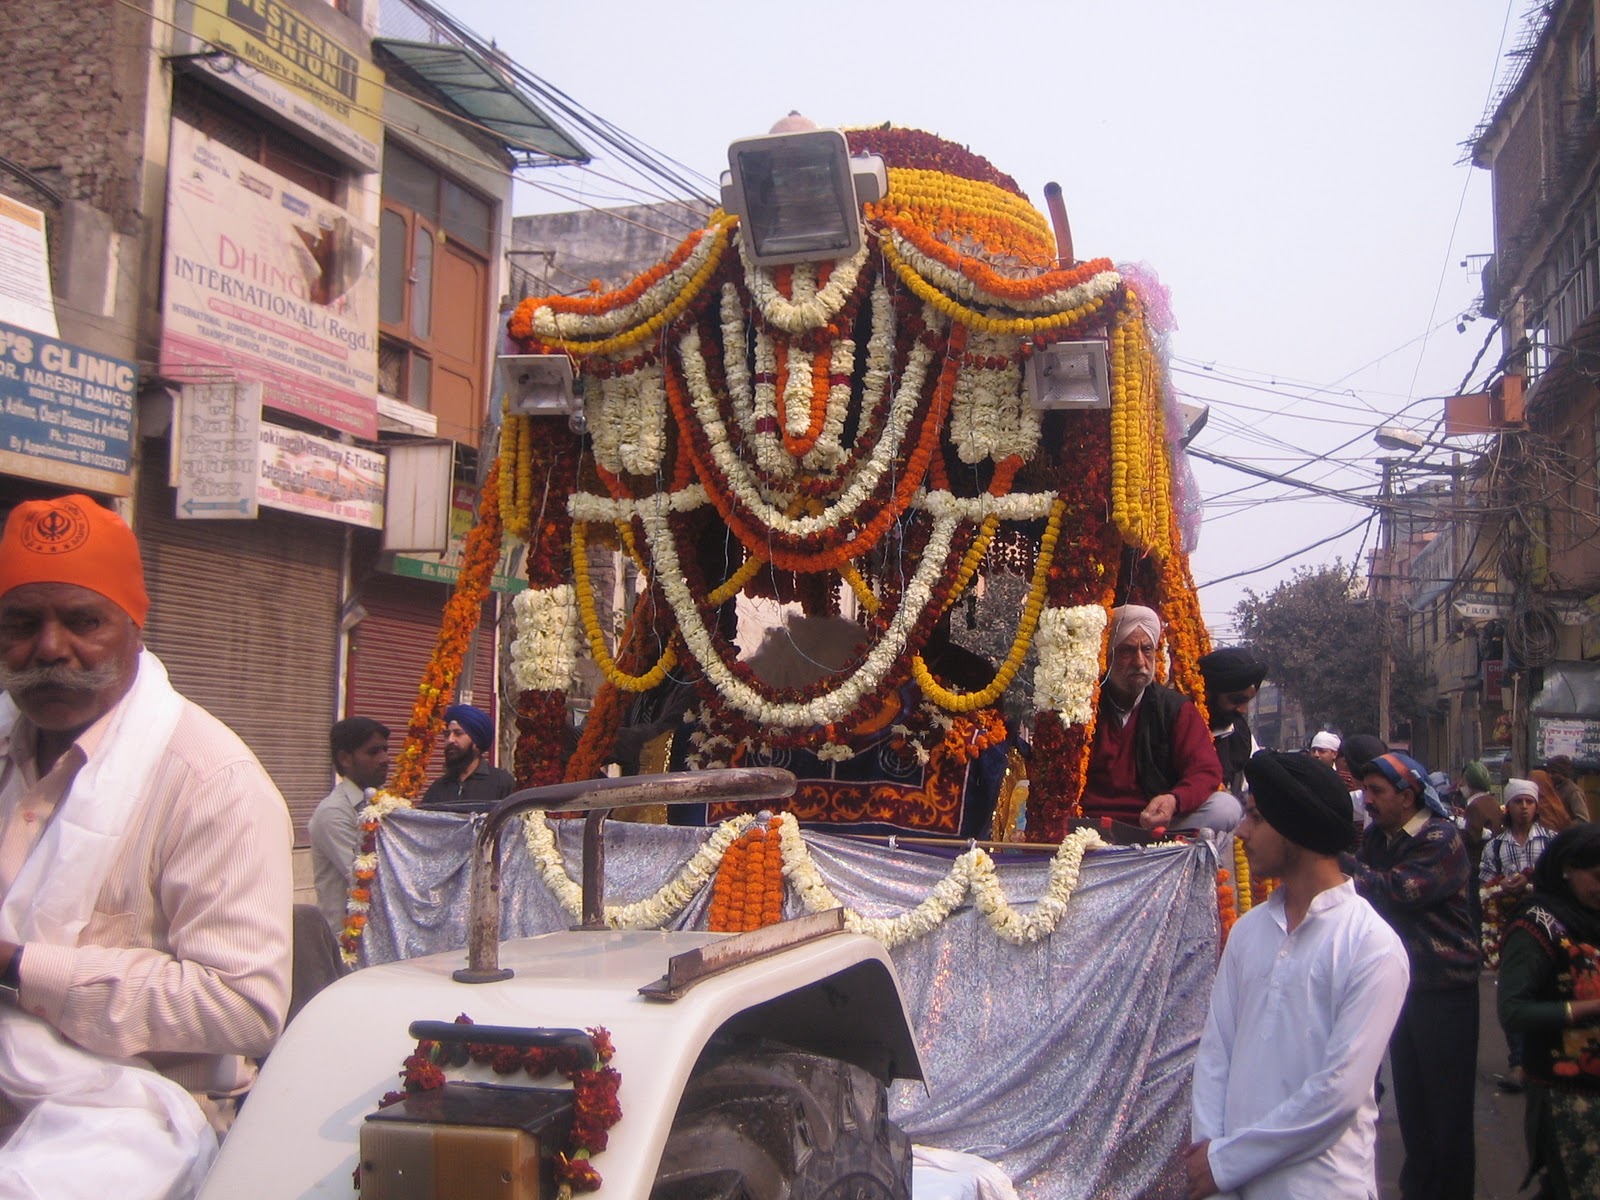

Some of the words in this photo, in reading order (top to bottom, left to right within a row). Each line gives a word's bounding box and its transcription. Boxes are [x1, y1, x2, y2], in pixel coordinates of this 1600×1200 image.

[245, 41, 290, 78] MONEY
[266, 24, 337, 88] UNION
[175, 255, 317, 329] INTERNATIONAL
[24, 368, 82, 395] NARESH
[85, 384, 133, 410] DANG'S
[41, 344, 134, 392] CLINIC
[1471, 607, 1491, 615] BLOCK
